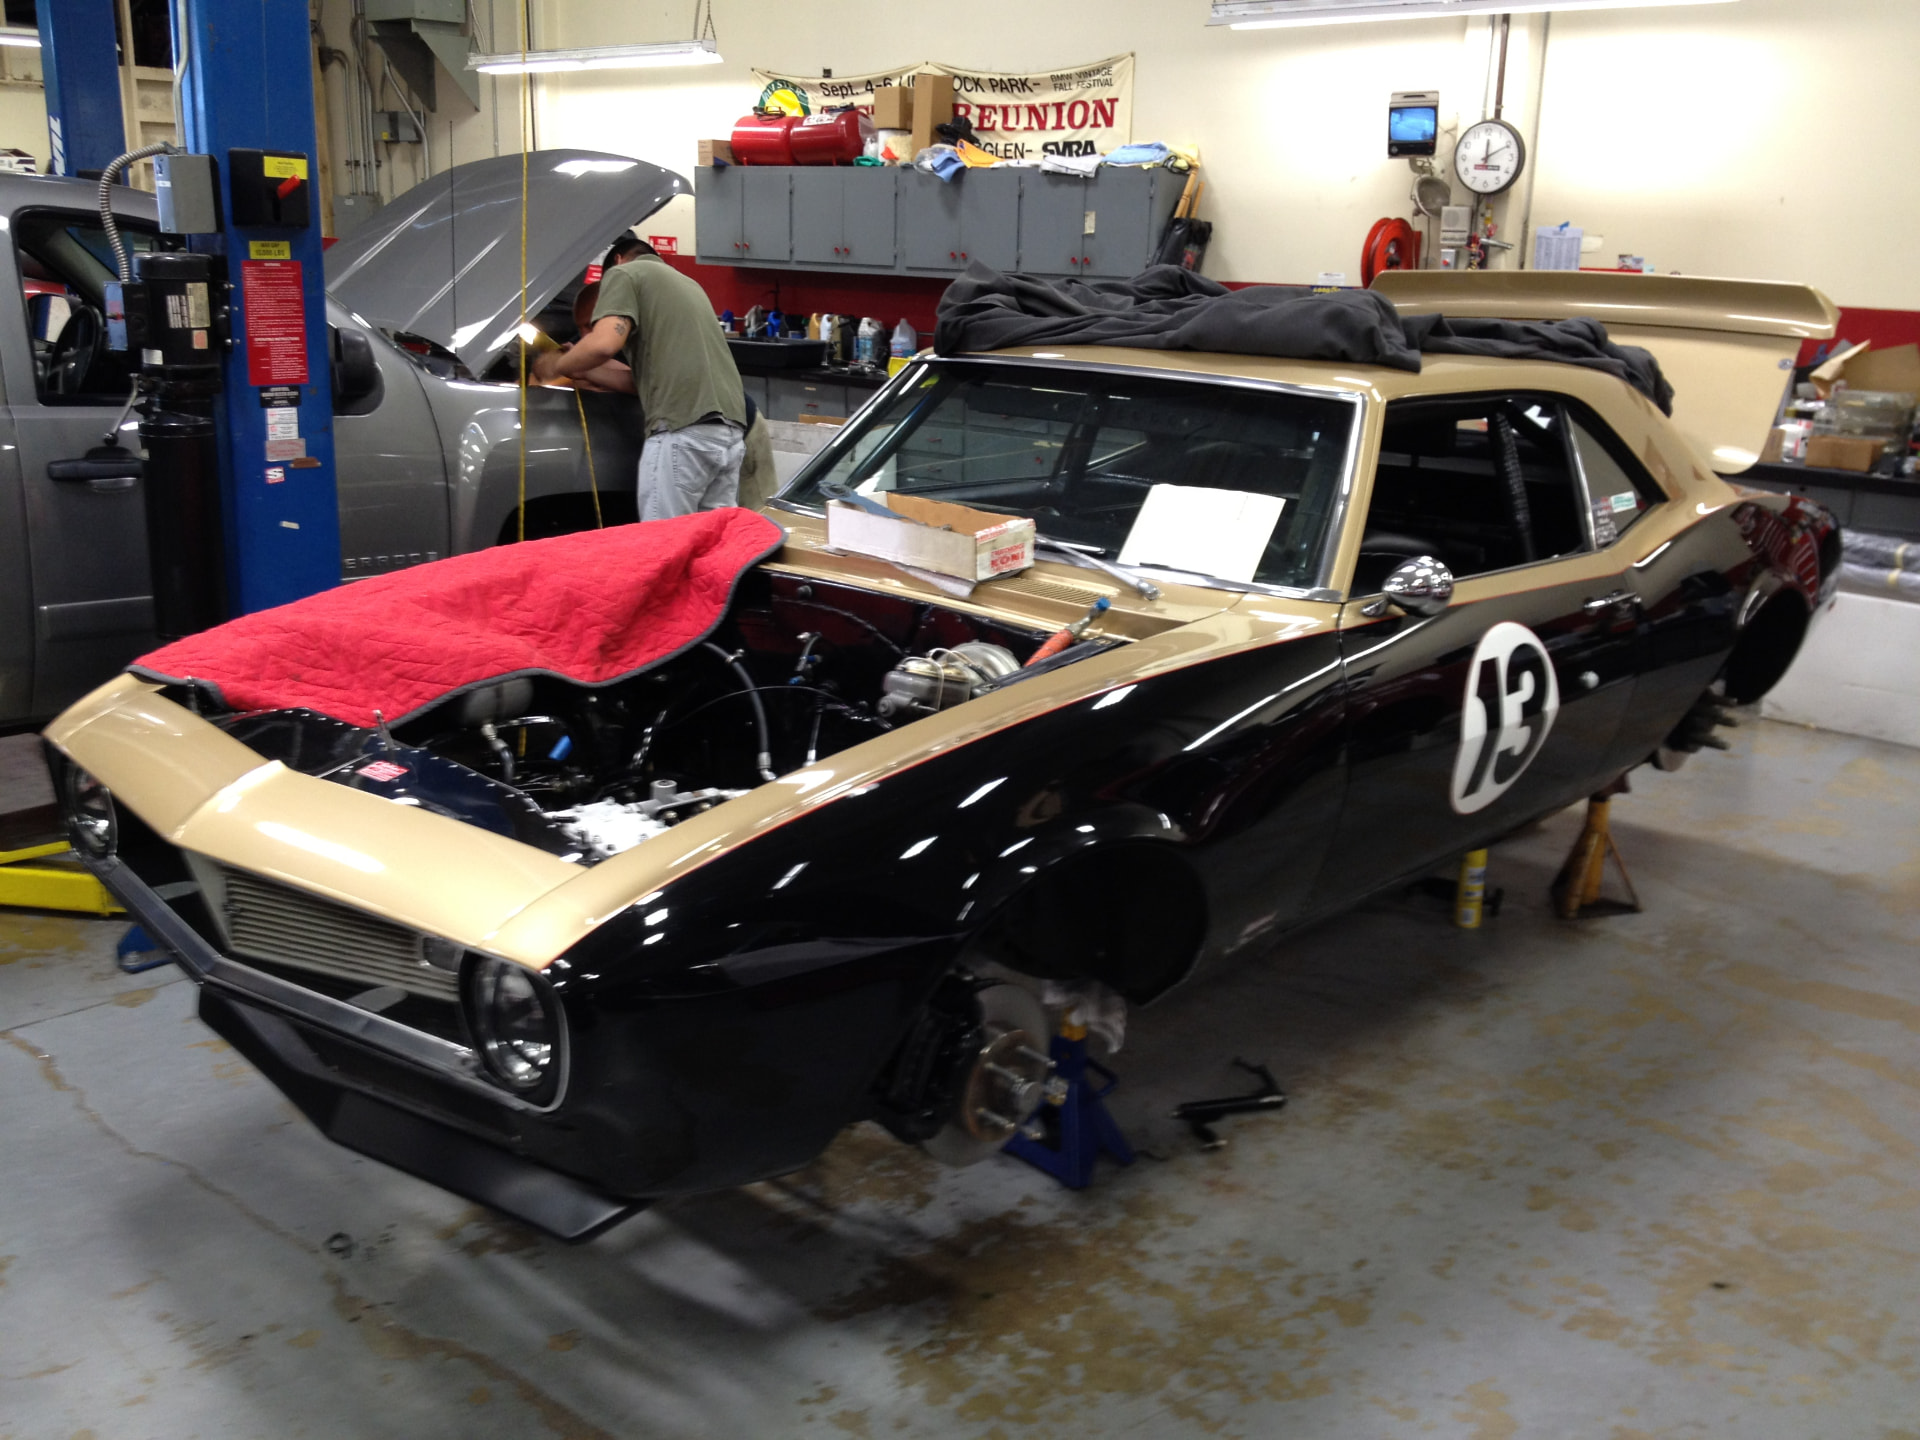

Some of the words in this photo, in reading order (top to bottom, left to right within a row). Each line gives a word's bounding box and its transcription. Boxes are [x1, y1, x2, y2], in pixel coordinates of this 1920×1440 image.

[1050, 72, 1073, 82] BMW
[1075, 67, 1112, 79] VINTAGE
[1053, 83, 1073, 92] FALL
[1076, 78, 1113, 89] FESTIVAL
[819, 82, 859, 99] Sept.
[953, 76, 985, 93] OCK
[952, 98, 1119, 132] REUNION
[990, 550, 1025, 569] KONI
[1460, 642, 1548, 800] 13
